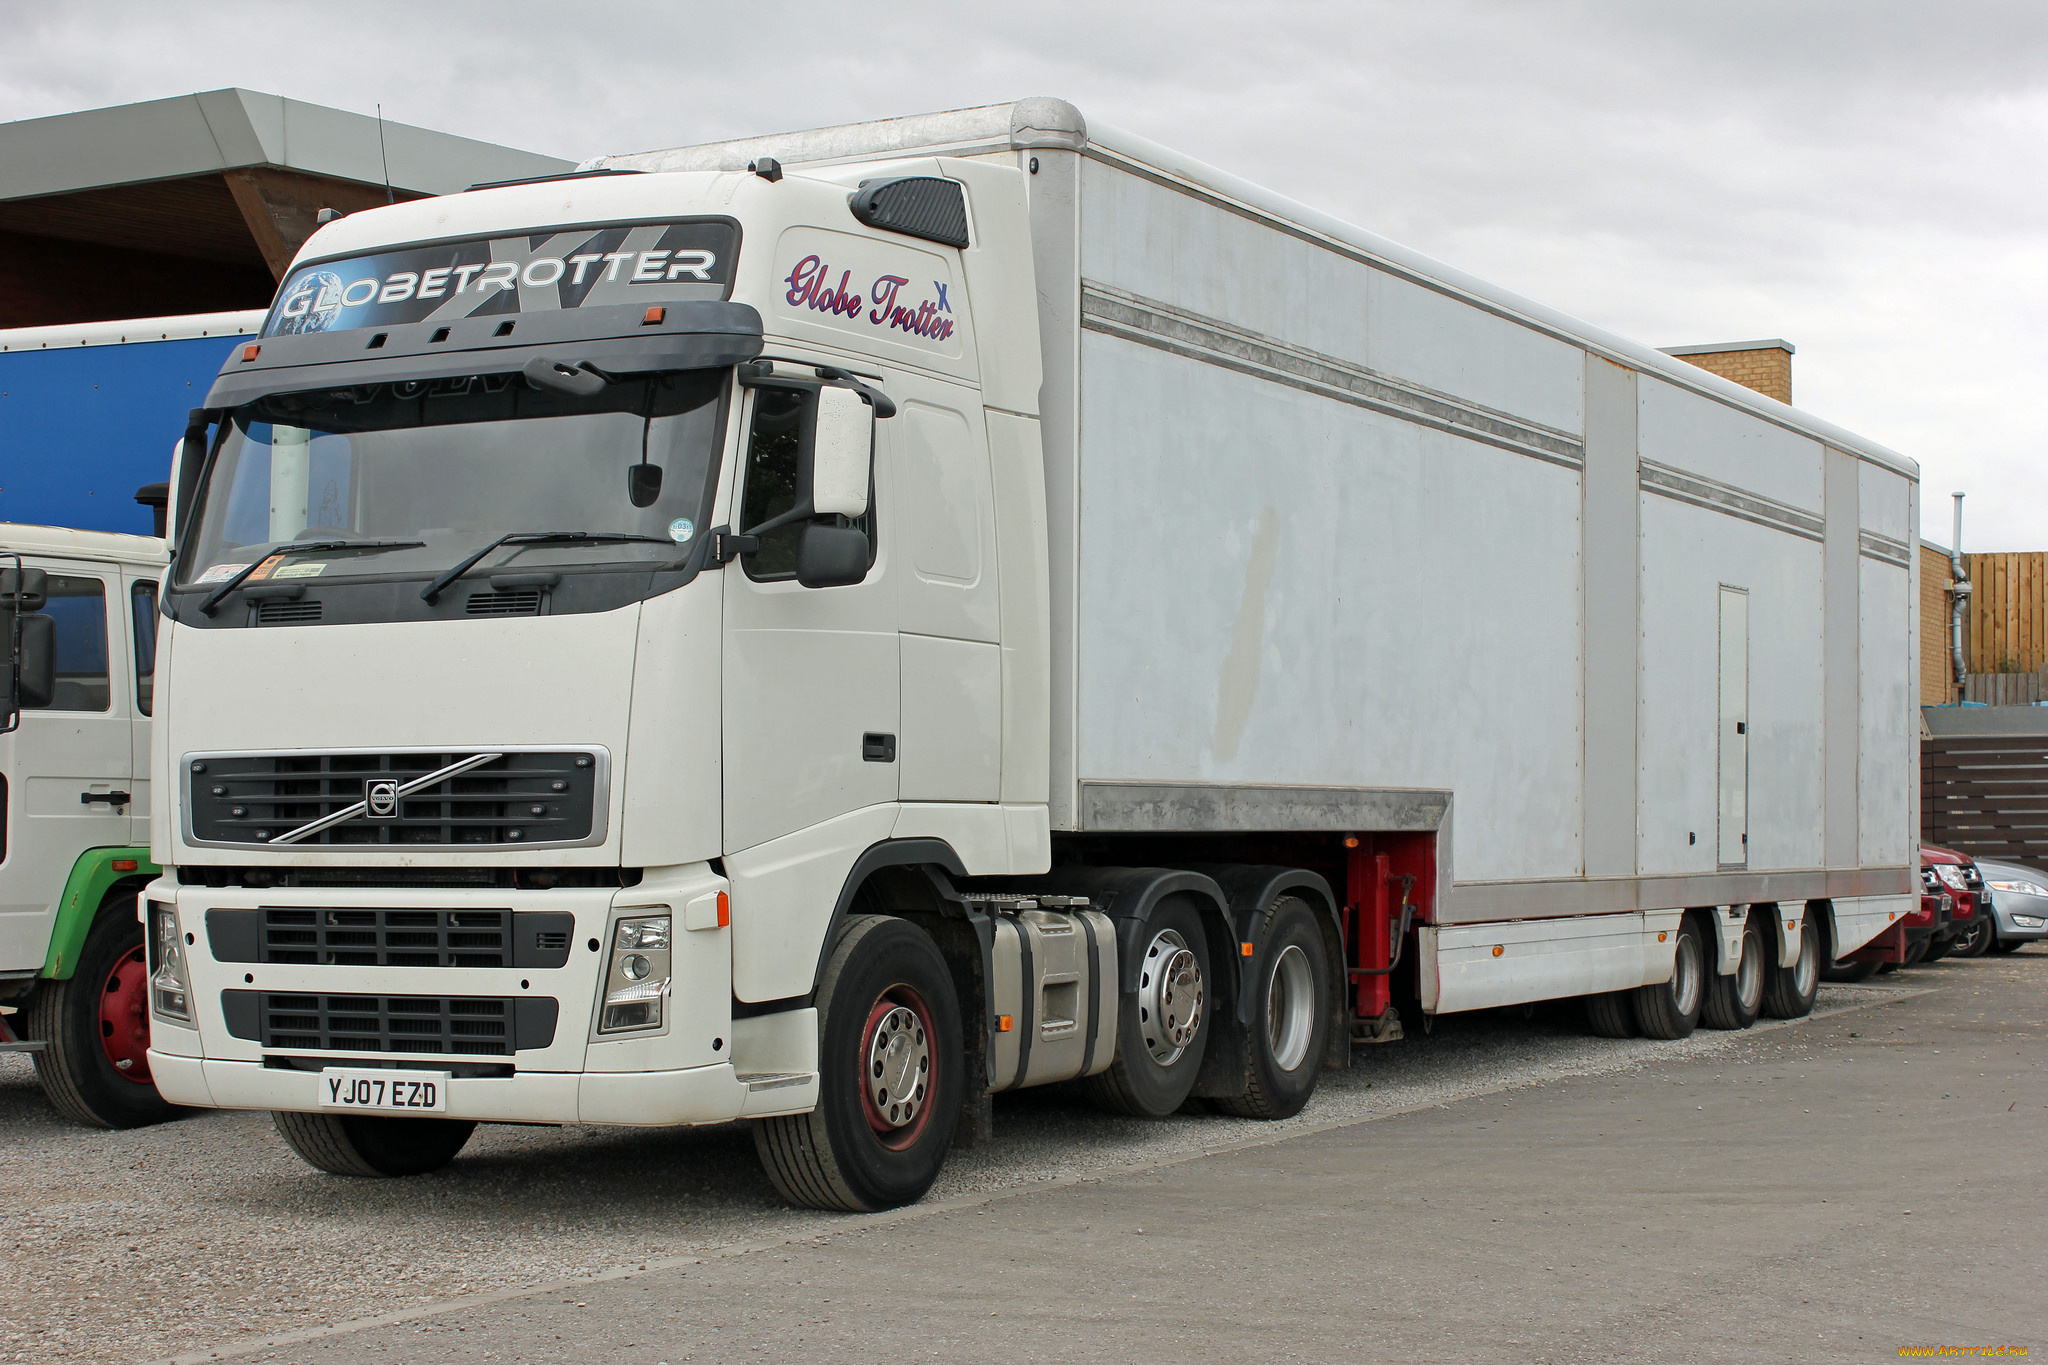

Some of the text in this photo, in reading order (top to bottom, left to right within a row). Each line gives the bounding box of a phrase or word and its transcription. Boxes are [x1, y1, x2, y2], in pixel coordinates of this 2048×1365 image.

[281, 248, 716, 321] GLOBETROTTER
[784, 254, 954, 342] Globe Trotter
[329, 1078, 437, 1108] YJ07 EZD
